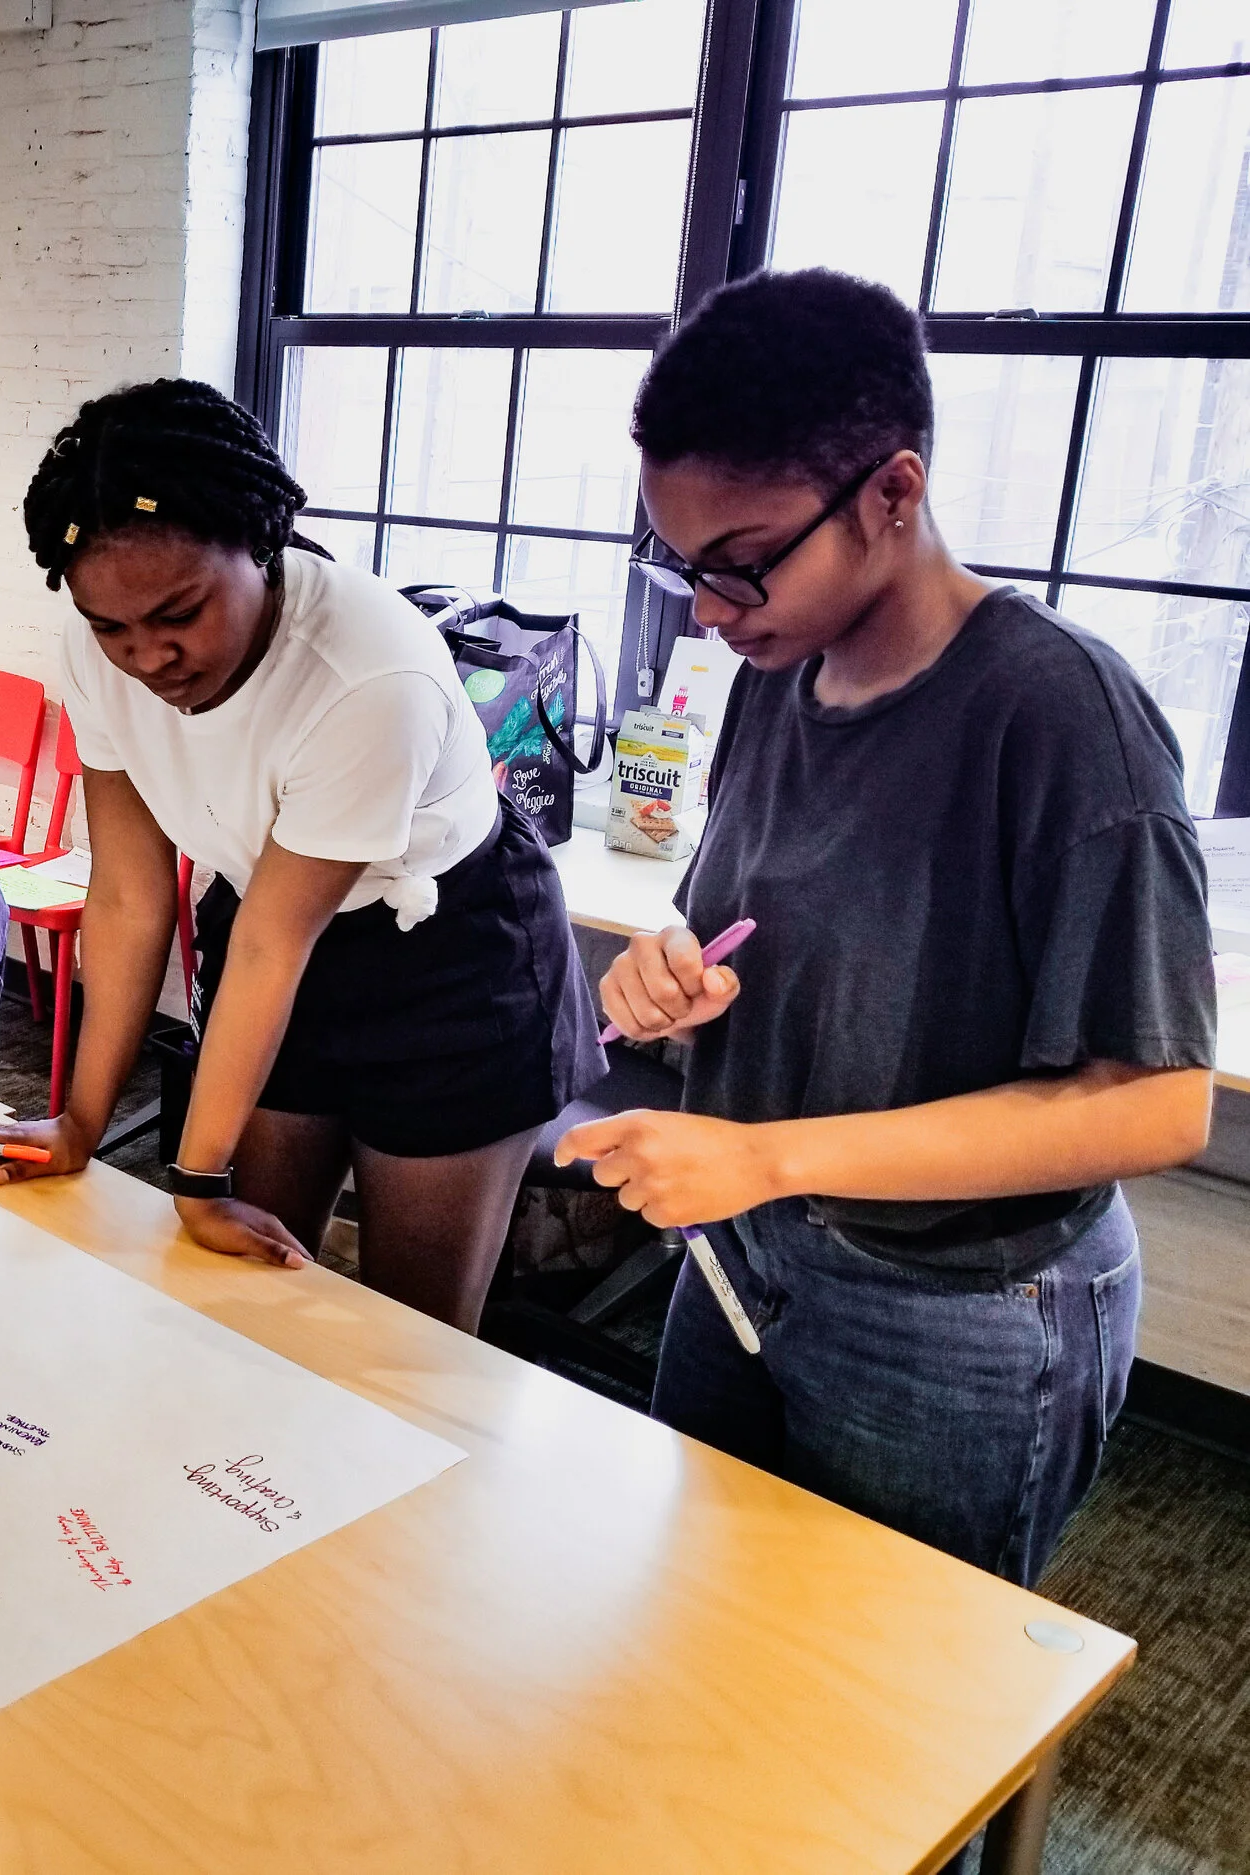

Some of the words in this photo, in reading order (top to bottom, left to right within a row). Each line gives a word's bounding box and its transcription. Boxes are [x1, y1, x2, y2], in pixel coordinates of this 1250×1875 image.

[634, 723, 655, 733] triscuit
[512, 767, 541, 791] Love
[618, 760, 682, 788] triscuit
[516, 785, 555, 814] Veggies
[629, 782, 663, 796] ORIGINAL
[6, 1414, 50, 1438] TOGETHER
[225, 1455, 294, 1510] Creating
[183, 1464, 279, 1532] Supporting
[70, 1508, 109, 1554] BALTIMORE
[70, 1549, 114, 1591] Thinking
